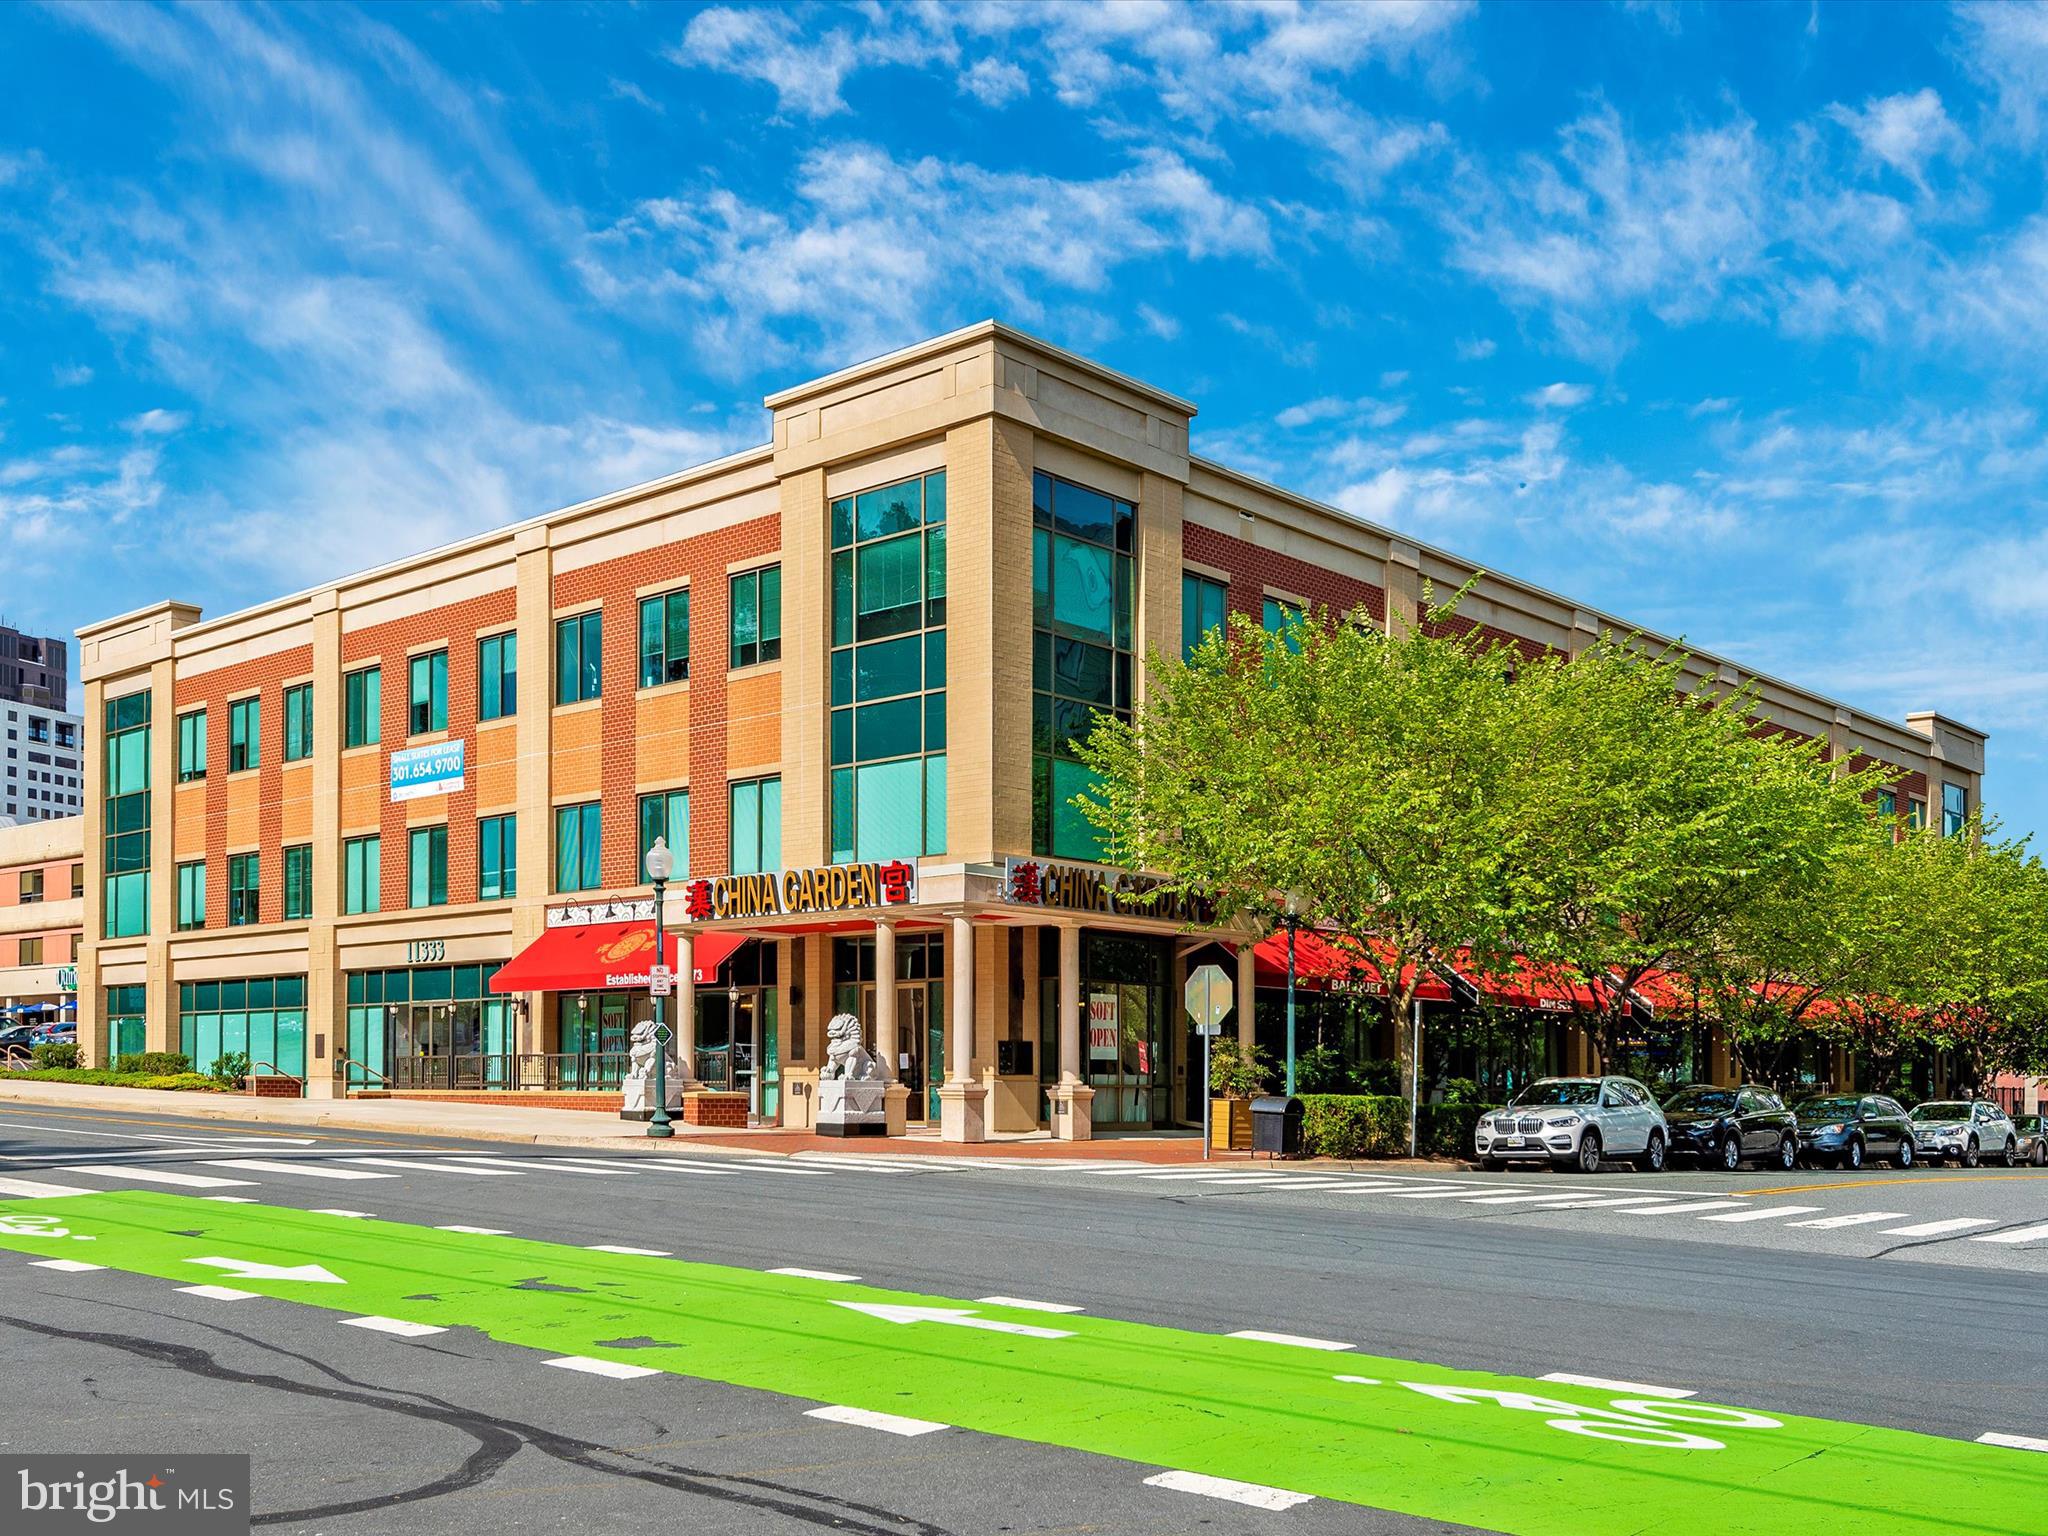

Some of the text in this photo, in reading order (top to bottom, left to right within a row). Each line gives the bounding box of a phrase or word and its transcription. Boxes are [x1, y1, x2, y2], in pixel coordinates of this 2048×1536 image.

[431, 747, 442, 756] FOR
[443, 744, 460, 754] LEASE
[392, 756, 461, 781] 301.654.9700
[714, 873, 778, 916] CHINA
[783, 863, 877, 911] GARDEN
[880, 859, 910, 902] 宮
[1045, 864, 1109, 913] CHINA
[407, 940, 445, 963] 11333
[1090, 1001, 1115, 1020] SOFT
[602, 1013, 623, 1029] SOFT
[602, 1035, 625, 1052] OPEN
[1090, 1028, 1116, 1047] OPEN
